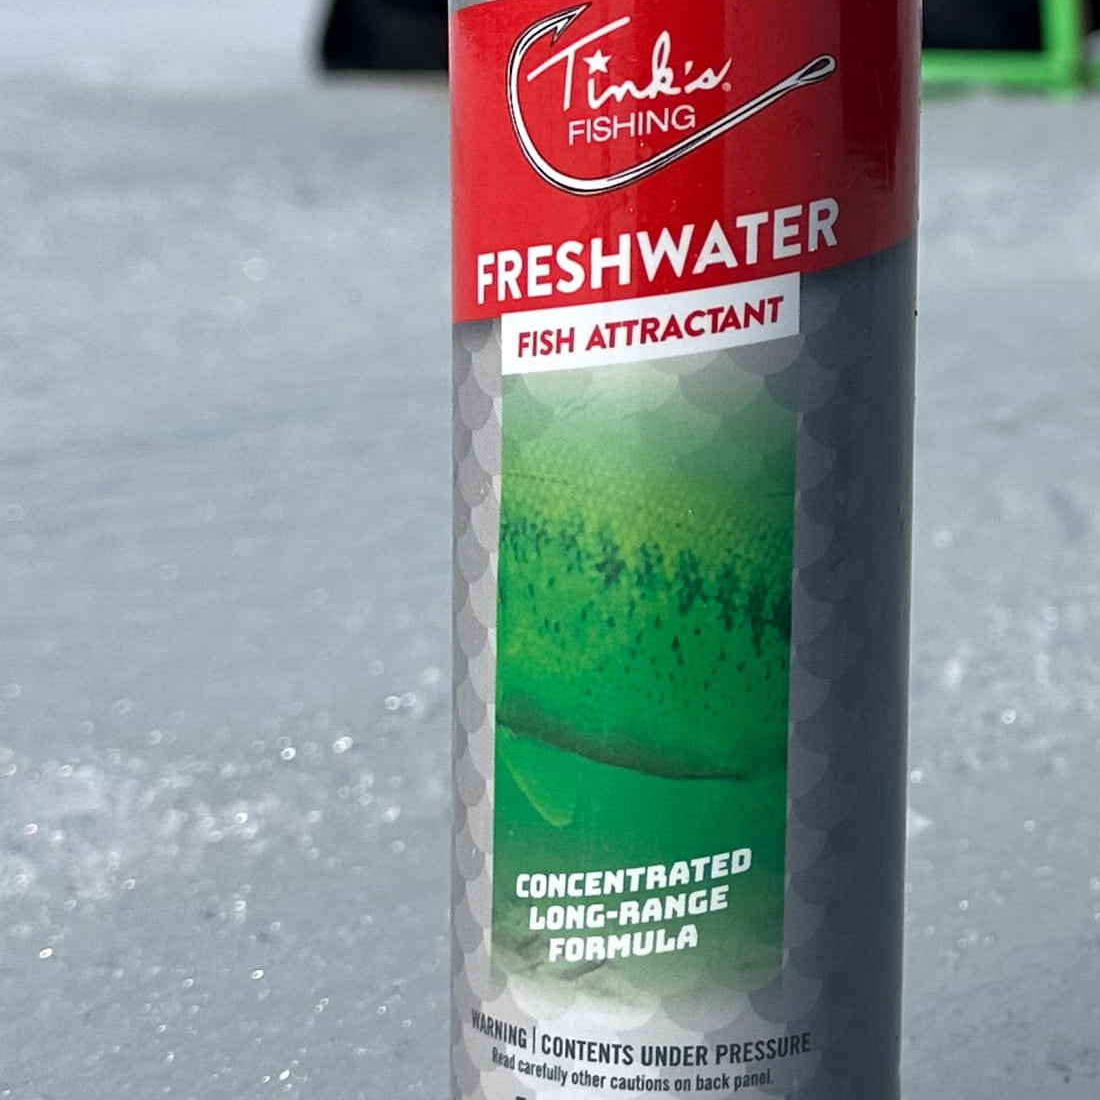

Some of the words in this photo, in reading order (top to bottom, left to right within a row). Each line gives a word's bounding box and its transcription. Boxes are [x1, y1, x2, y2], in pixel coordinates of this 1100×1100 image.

[527, 16, 732, 111] Tink's
[568, 105, 695, 145] FISHING
[477, 197, 839, 304] FRESHWATER
[517, 327, 575, 358] FISH
[585, 296, 784, 351] ATTRACTANT
[516, 848, 752, 898] CONCENTRATED
[529, 885, 729, 930] LONG-RANGE
[549, 924, 698, 962] FORMULA
[471, 1008, 527, 1049] WARNING
[541, 1034, 634, 1066] CONTENTS
[640, 1045, 708, 1067] UNDER
[715, 1032, 811, 1065] PRESSURE
[491, 1047, 515, 1070] Read
[518, 1059, 568, 1087] carefully
[571, 1070, 606, 1088] other
[610, 1074, 670, 1091] cautions
[674, 1077, 691, 1091] on
[695, 1073, 730, 1091] back
